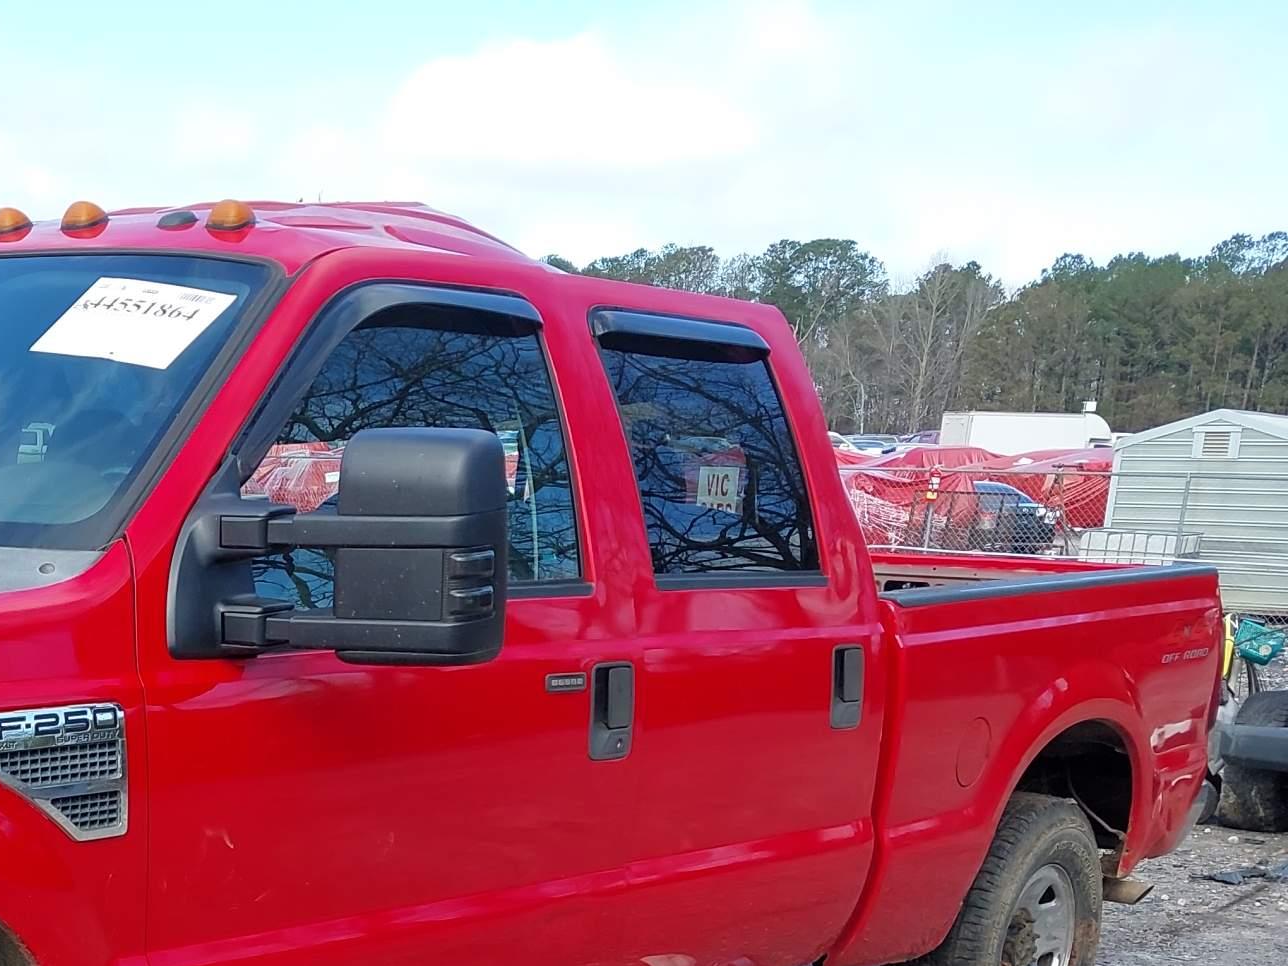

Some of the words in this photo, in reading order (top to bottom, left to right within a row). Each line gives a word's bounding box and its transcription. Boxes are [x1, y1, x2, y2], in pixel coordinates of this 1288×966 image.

[706, 473, 730, 497] VIC
[1161, 653, 1182, 664] OFF
[1183, 648, 1209, 660] ROAD
[57, 734, 89, 745] SUPER
[93, 730, 120, 740] DUTY
